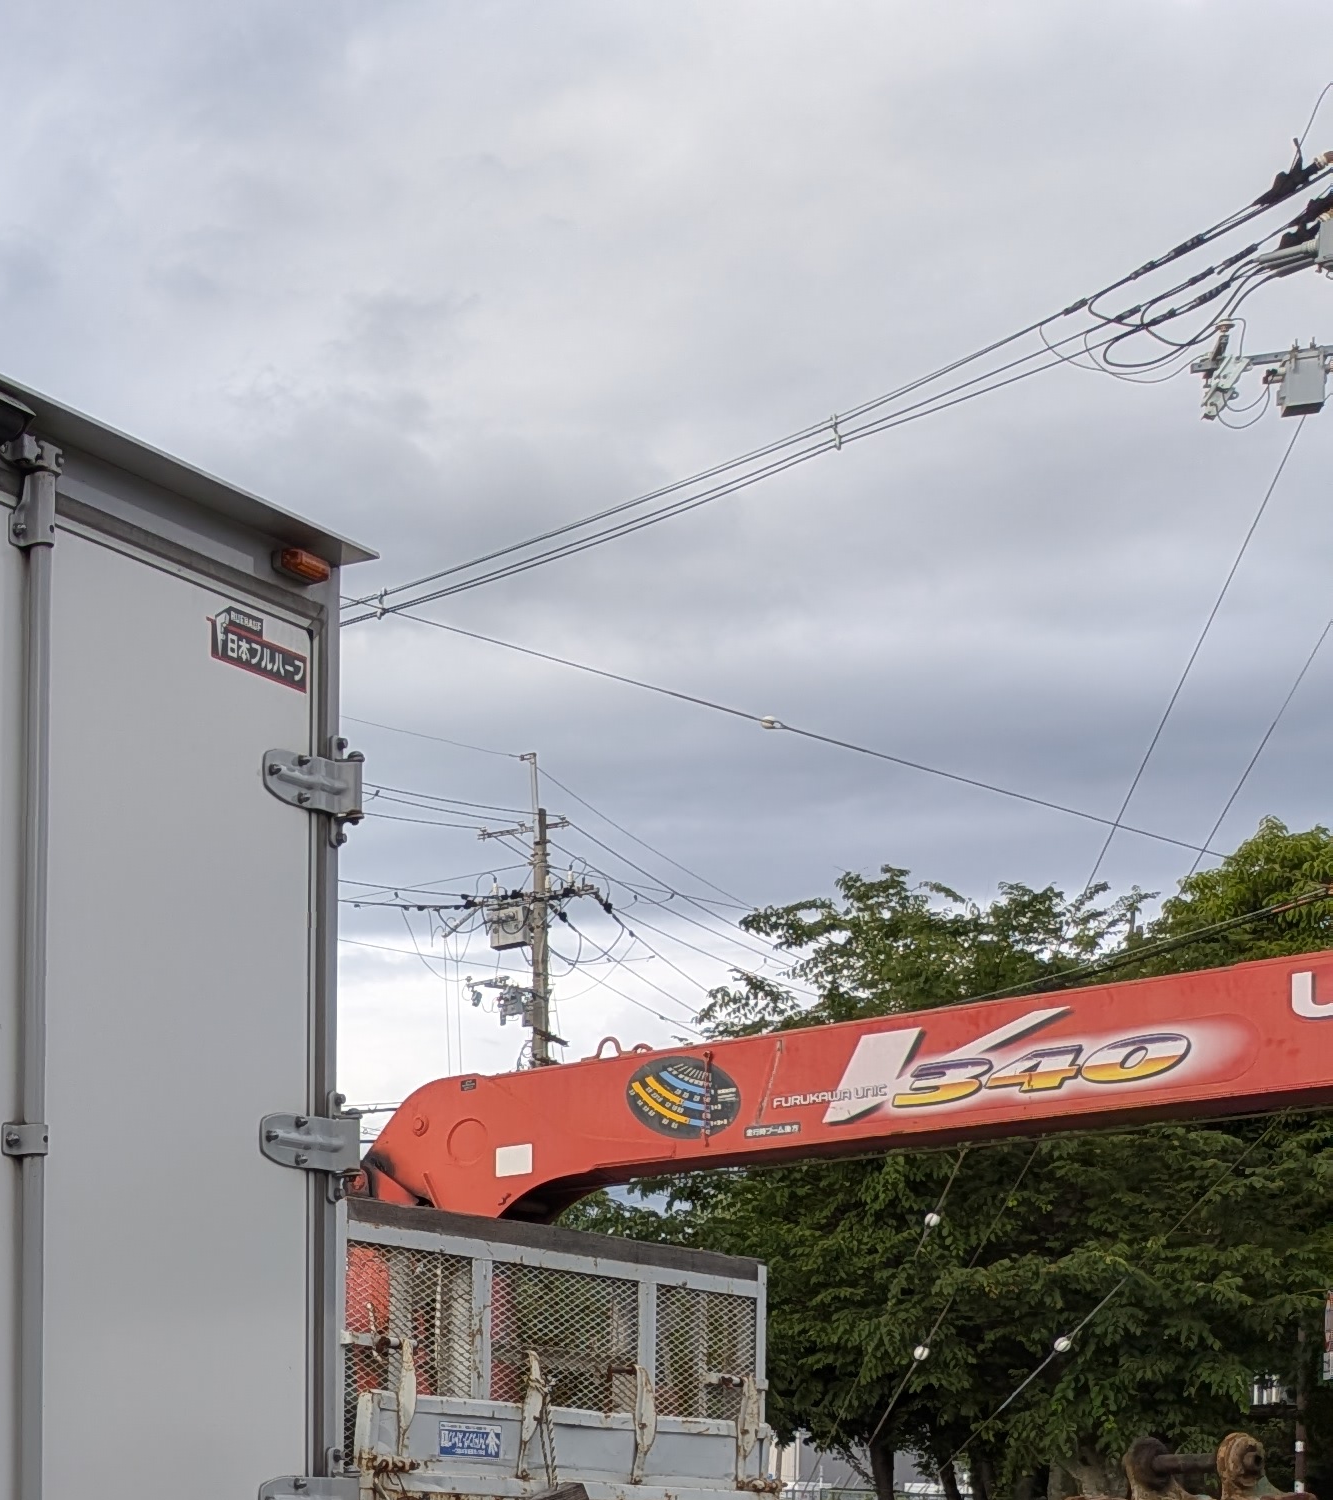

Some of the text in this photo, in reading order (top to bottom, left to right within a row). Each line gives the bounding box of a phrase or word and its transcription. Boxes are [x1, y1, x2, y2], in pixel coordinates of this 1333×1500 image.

[227, 632, 304, 681] 日本フルハーフ
[773, 1084, 888, 1108] FURUKAWA UNIC
